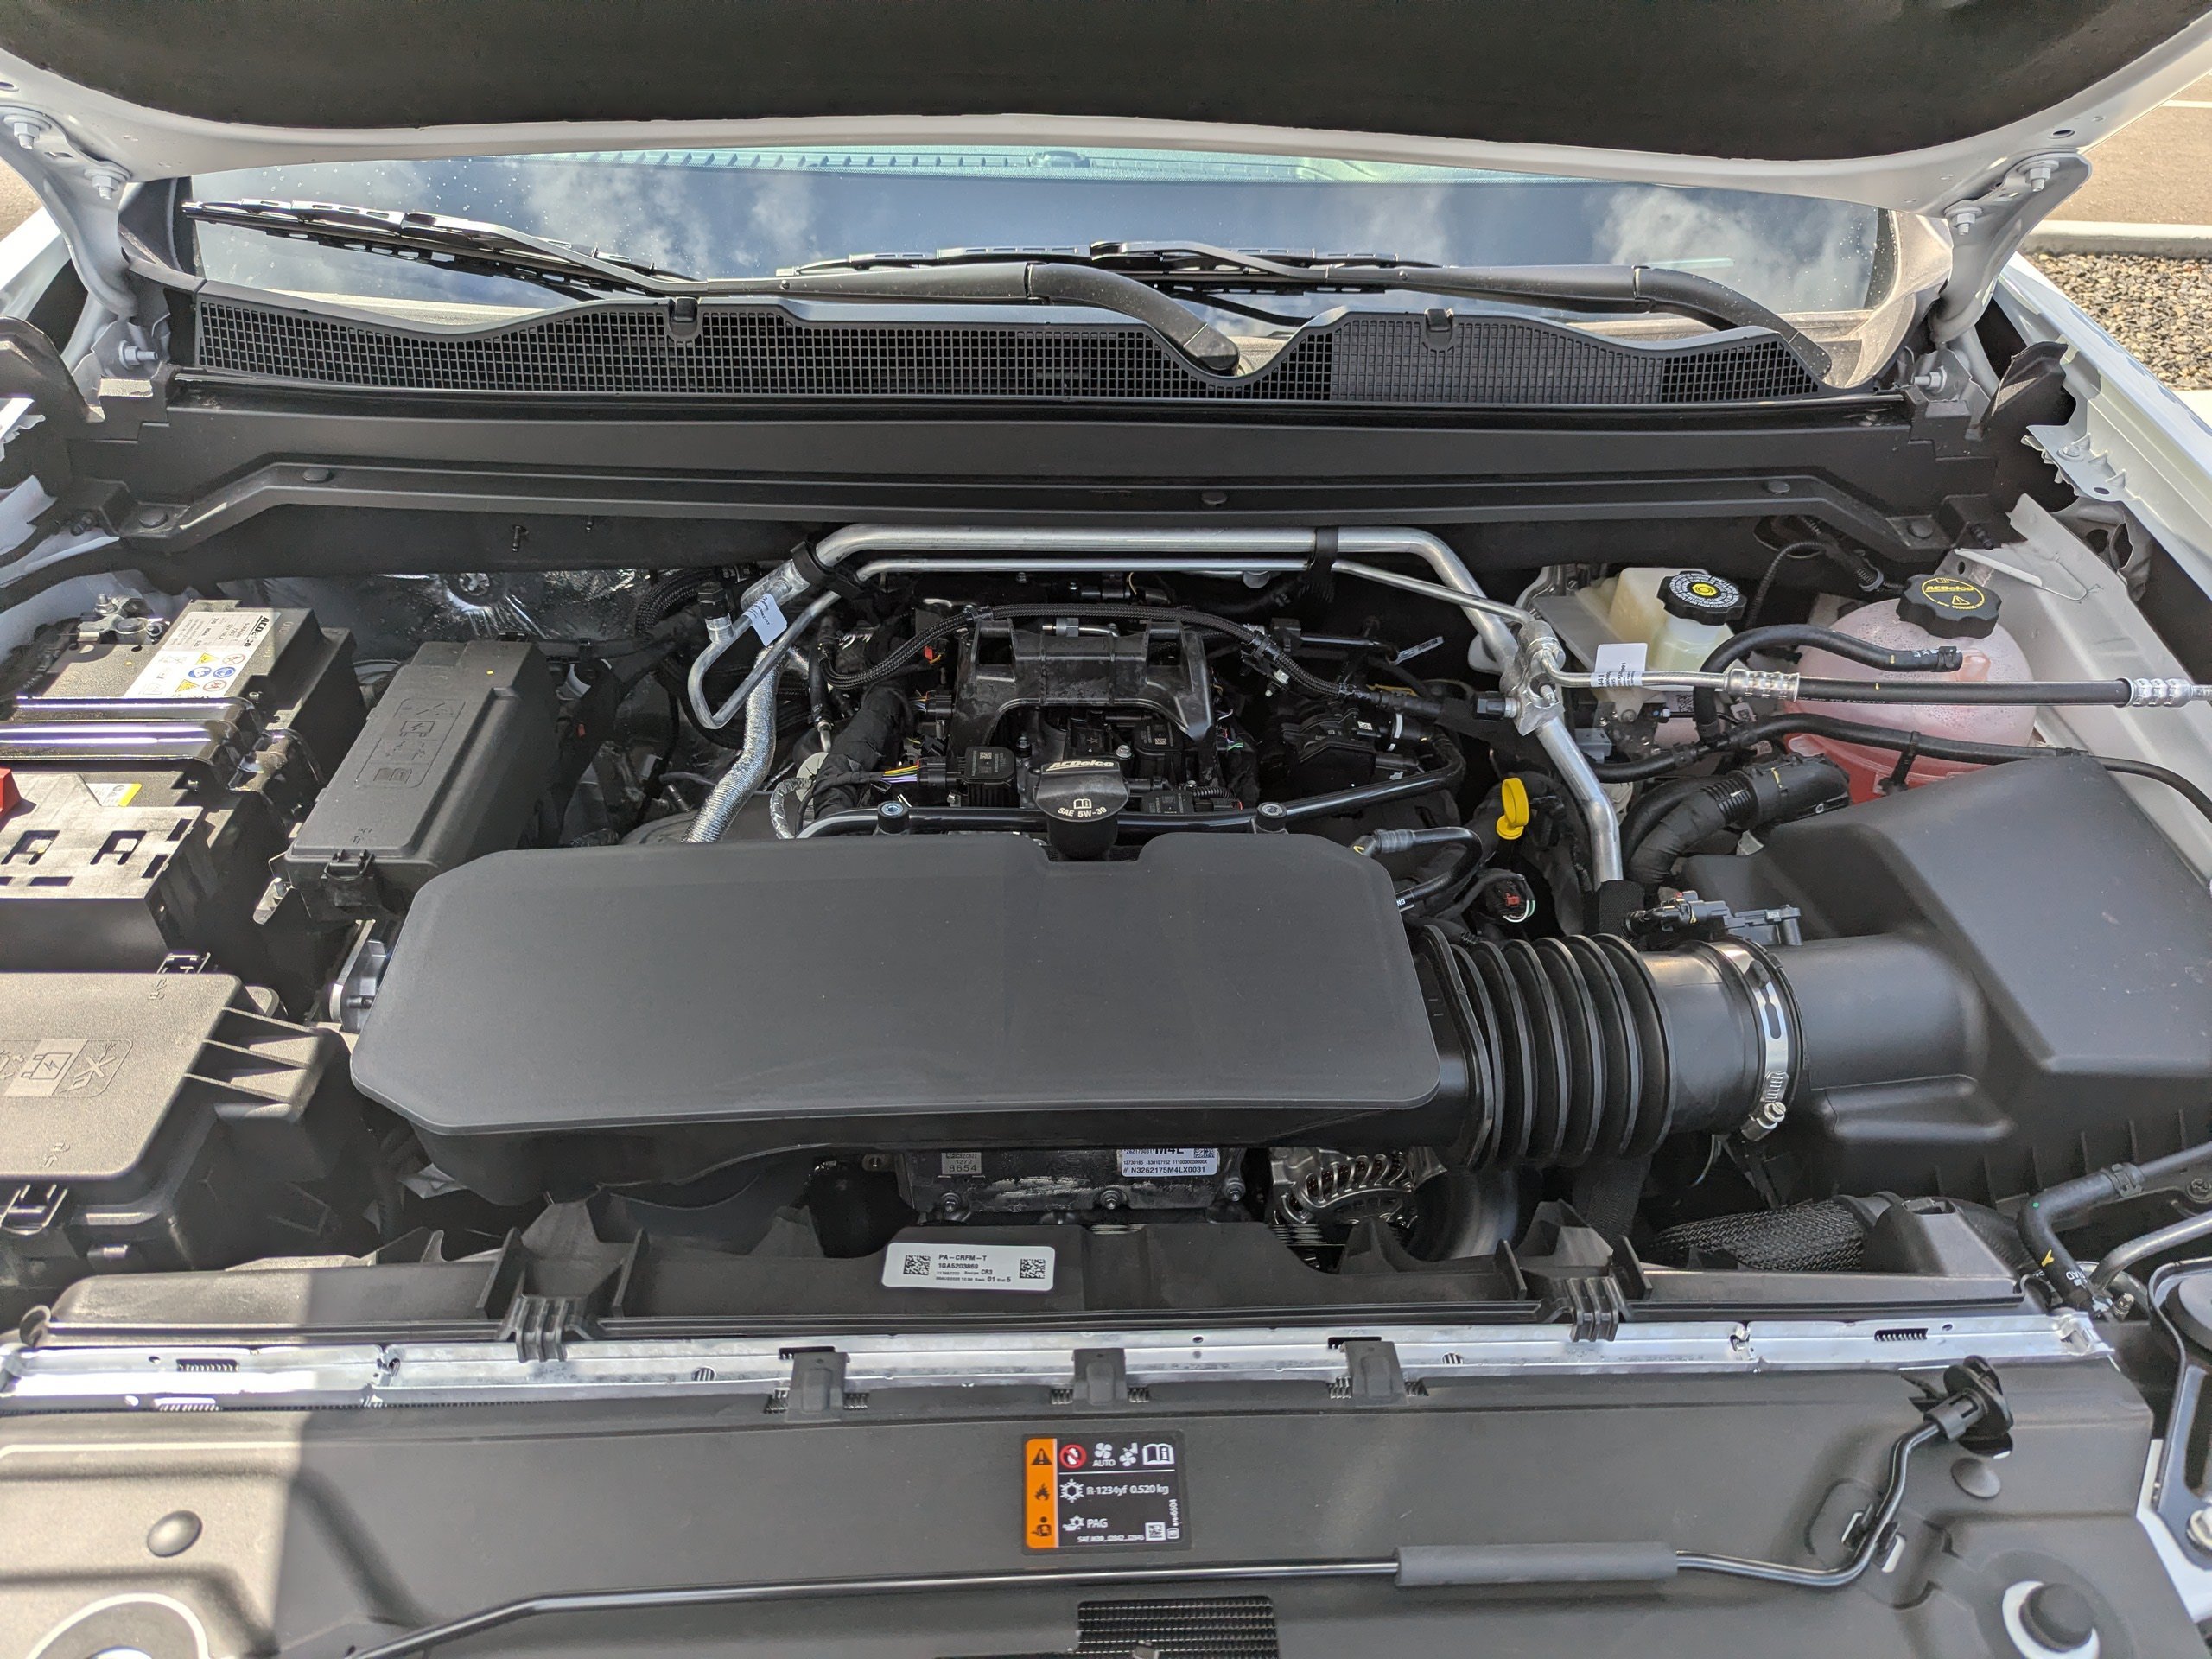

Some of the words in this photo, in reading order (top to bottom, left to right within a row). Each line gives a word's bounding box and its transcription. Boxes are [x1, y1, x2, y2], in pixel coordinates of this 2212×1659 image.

[244, 616, 270, 647] ACDelco
[1046, 760, 1115, 772] ACDelco
[1058, 807, 1075, 817] SAE
[1077, 806, 1107, 817] 5W-30
[1092, 1459, 1116, 1467] AUTO
[1085, 1484, 1128, 1497] R-1234yf
[1156, 1484, 1170, 1495] kg
[1086, 1518, 1109, 1529] PAG
